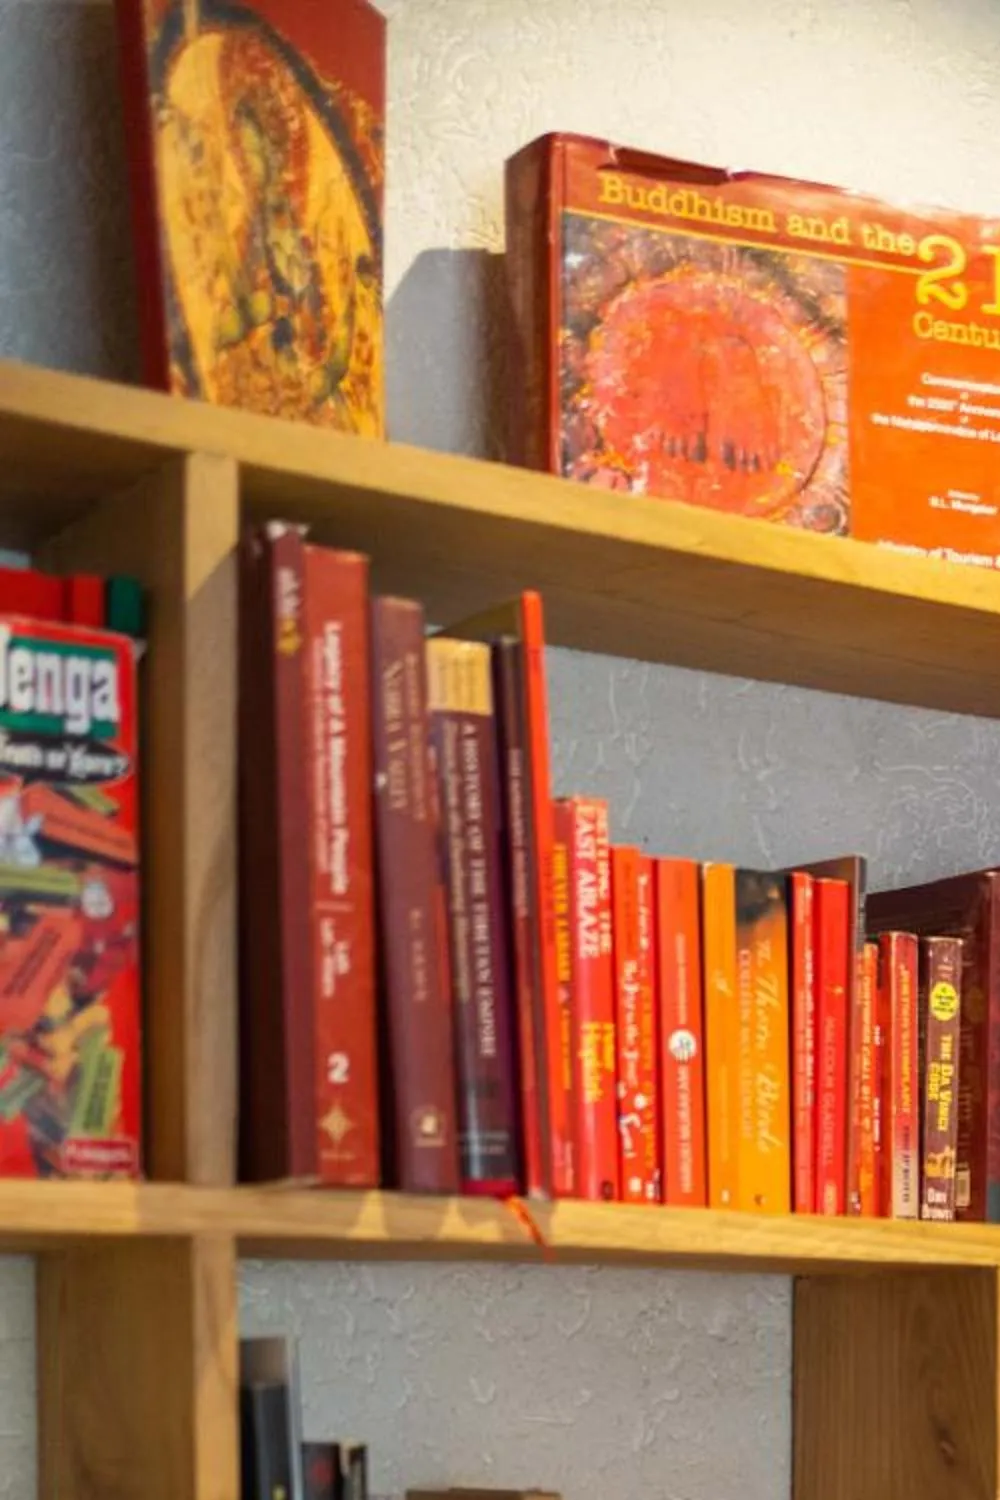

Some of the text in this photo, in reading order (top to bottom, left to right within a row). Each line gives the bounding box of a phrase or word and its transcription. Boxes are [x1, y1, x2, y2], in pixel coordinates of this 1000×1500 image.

[597, 173, 917, 257] Buddhism and the
[575, 804, 600, 959] EAST ABLAZE
[327, 1052, 350, 1084] 2
[927, 1062, 940, 1101] CODE
[937, 1035, 955, 1131] THE DA VINCI
